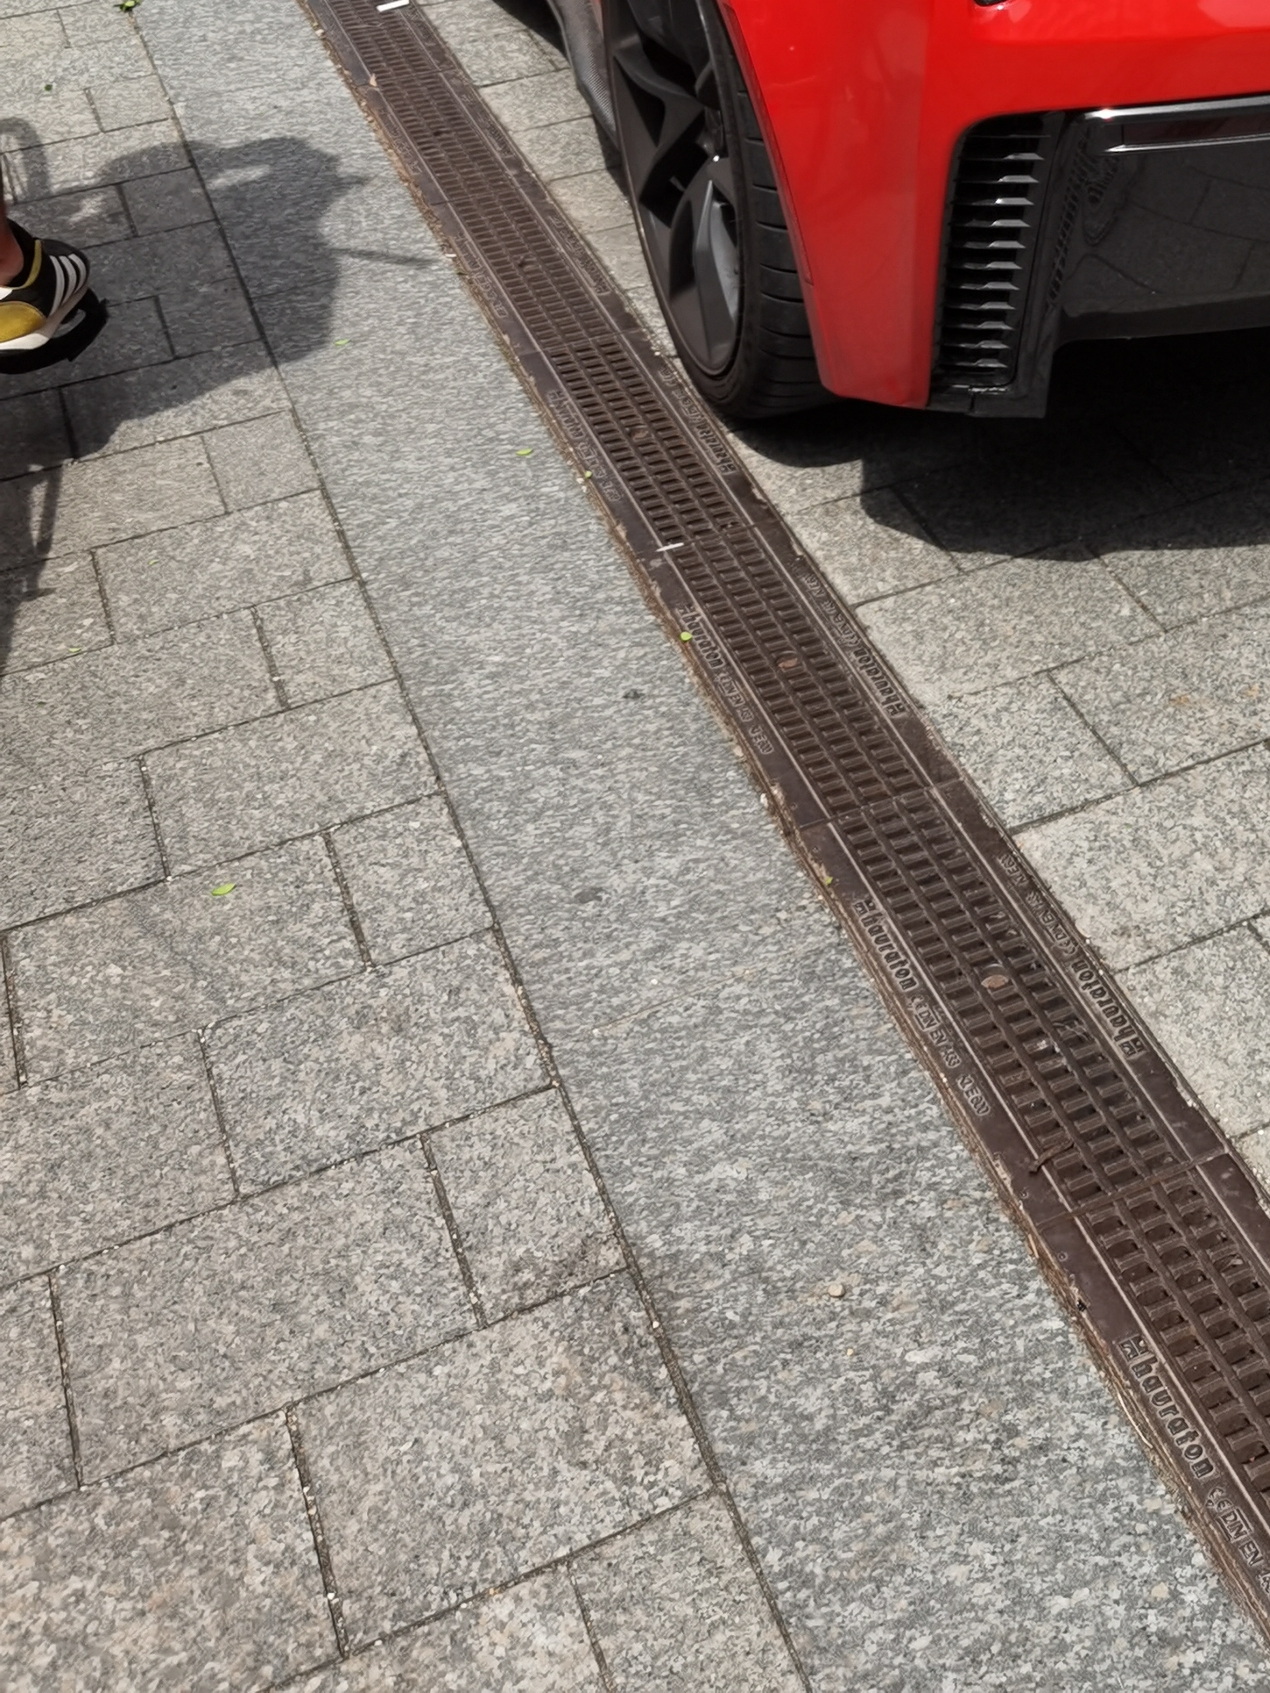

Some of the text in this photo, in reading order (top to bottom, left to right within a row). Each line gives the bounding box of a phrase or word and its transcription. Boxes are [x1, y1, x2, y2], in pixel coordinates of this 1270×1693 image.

[866, 908, 918, 992] hauraton
[1068, 958, 1130, 1043] hauraton
[1131, 1353, 1215, 1479] hauraton
[1217, 1508, 1250, 1544] DIN
[1238, 1542, 1265, 1566] EN
